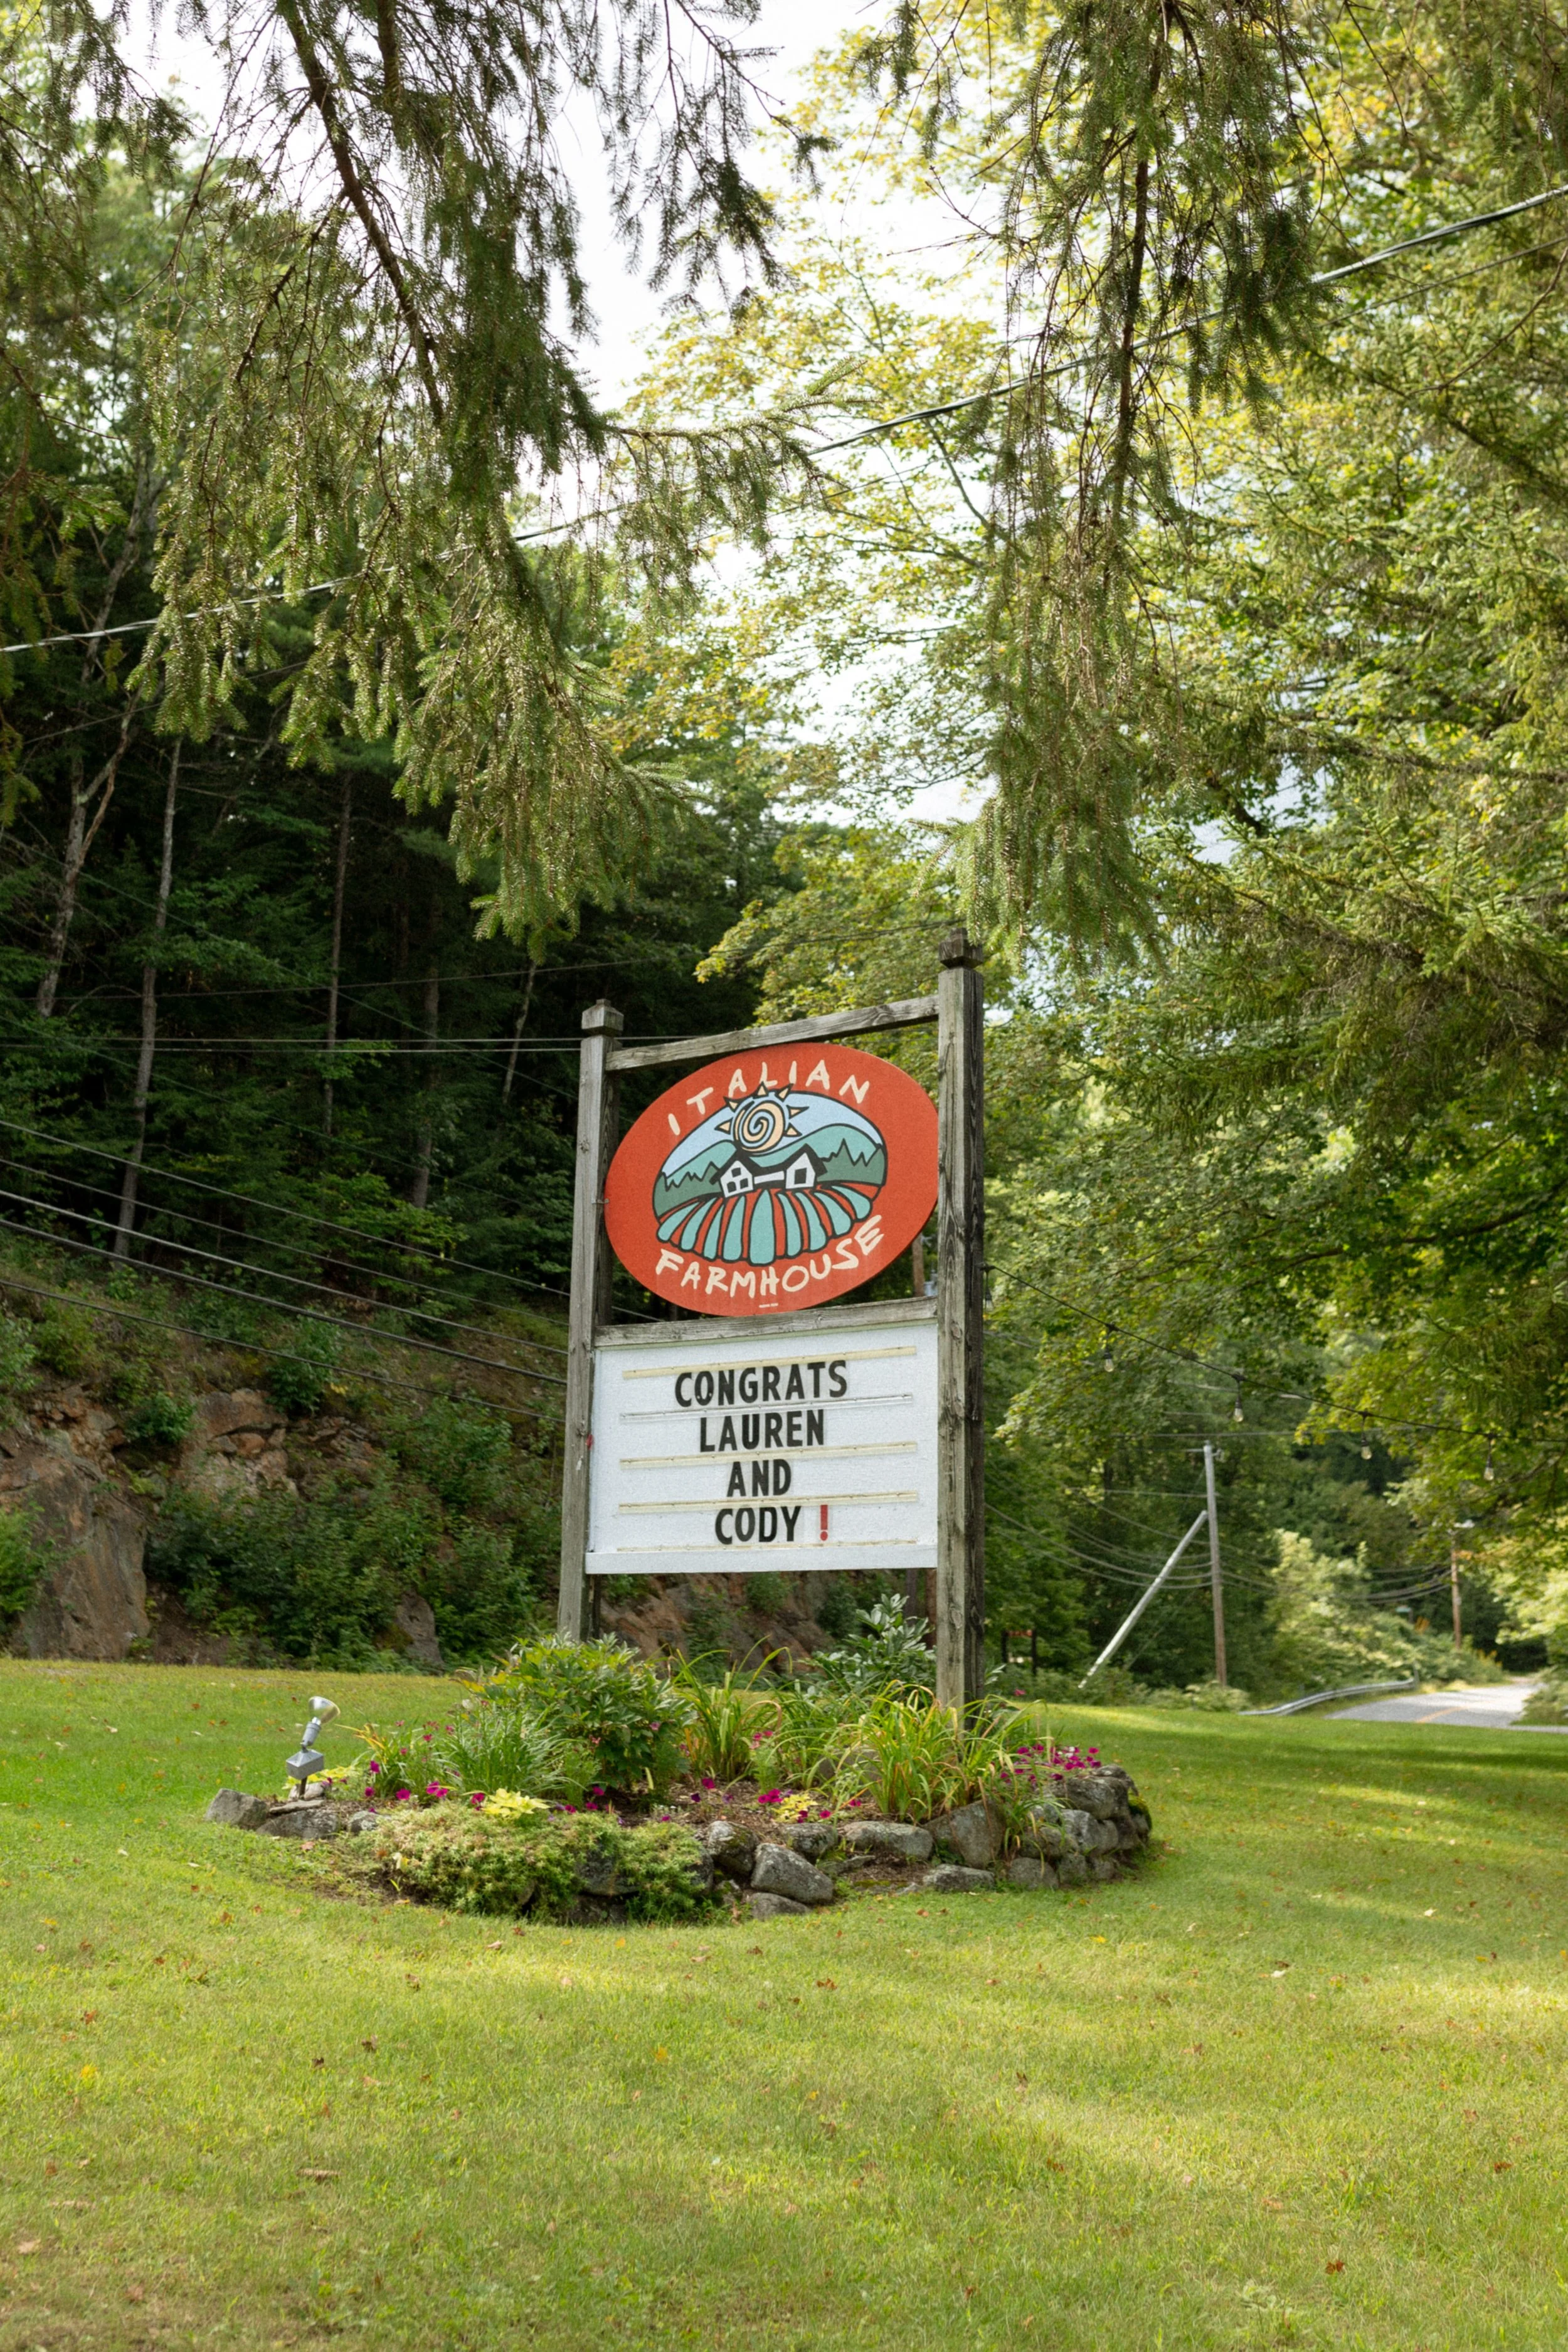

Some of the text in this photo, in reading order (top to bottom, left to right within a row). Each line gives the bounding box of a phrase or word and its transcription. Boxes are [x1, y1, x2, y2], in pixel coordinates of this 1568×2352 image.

[668, 1059, 870, 1136] ITALIAN
[655, 1214, 884, 1299] FARMHOUSE
[674, 1360, 847, 1407] CONGRATS
[700, 1409, 824, 1453] LAUREN
[727, 1459, 792, 1497] AND
[715, 1505, 802, 1544] CODY
